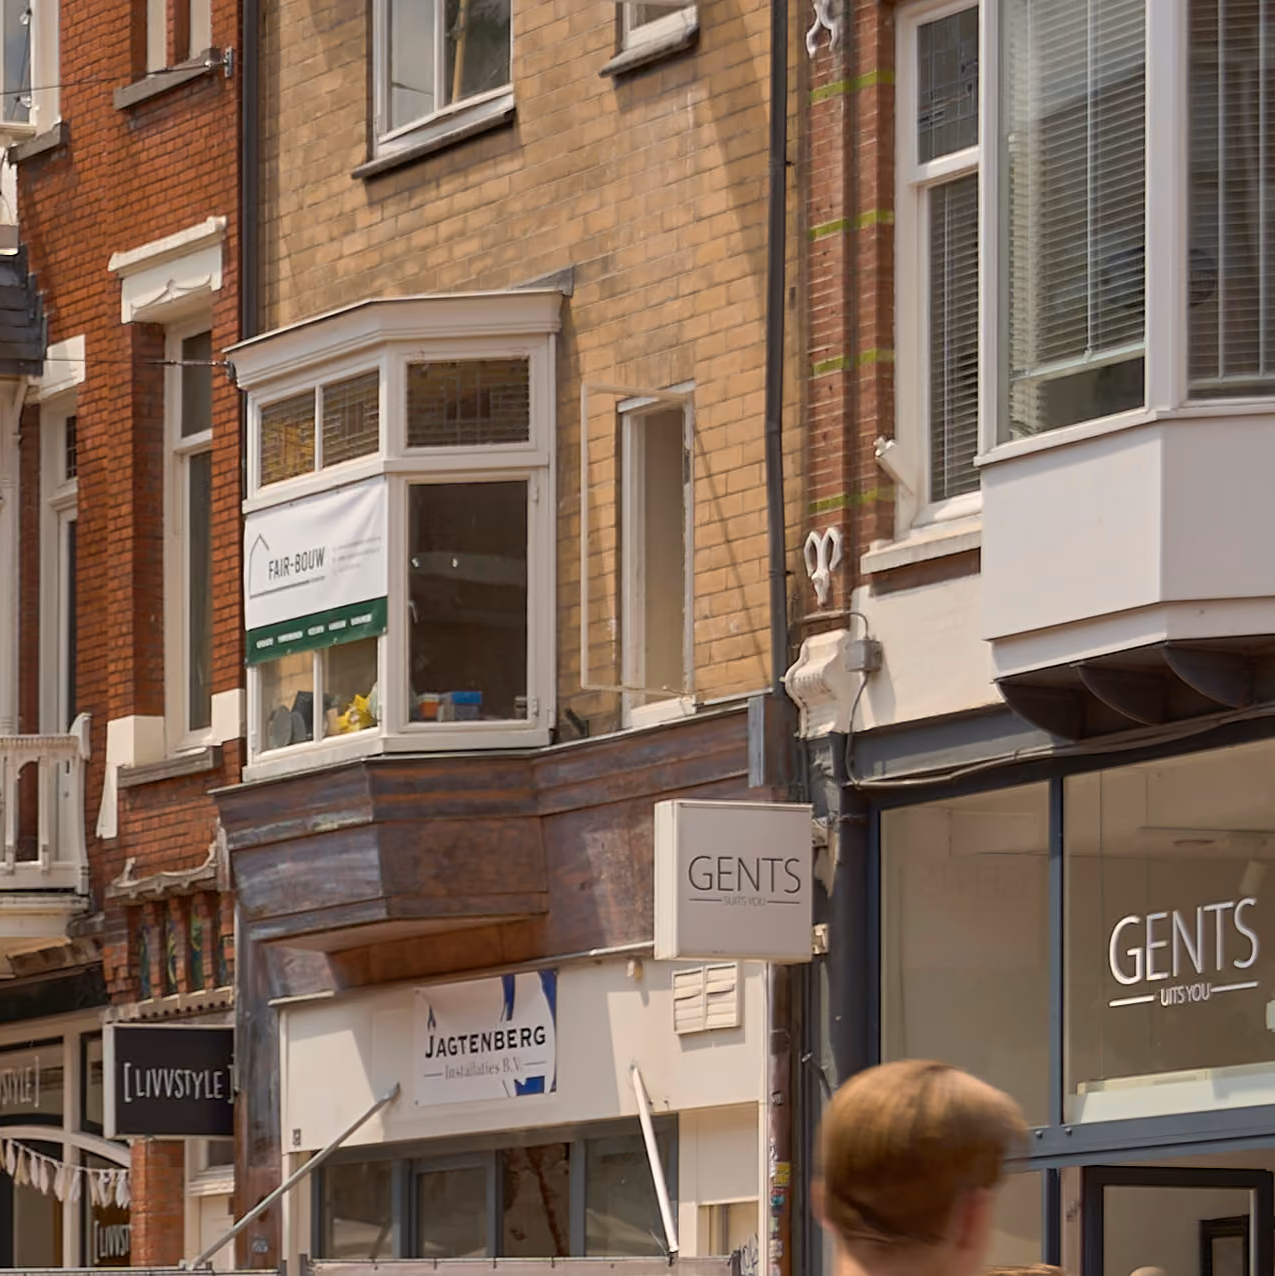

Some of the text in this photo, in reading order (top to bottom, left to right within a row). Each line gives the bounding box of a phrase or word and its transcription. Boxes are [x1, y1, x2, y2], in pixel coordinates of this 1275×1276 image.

[268, 547, 326, 581] FAIR-BOUW
[688, 855, 801, 893] GENTS
[1108, 897, 1260, 985] GENTS
[1185, 983, 1212, 1003] YOU
[425, 1026, 547, 1059] JAGTENBERG
